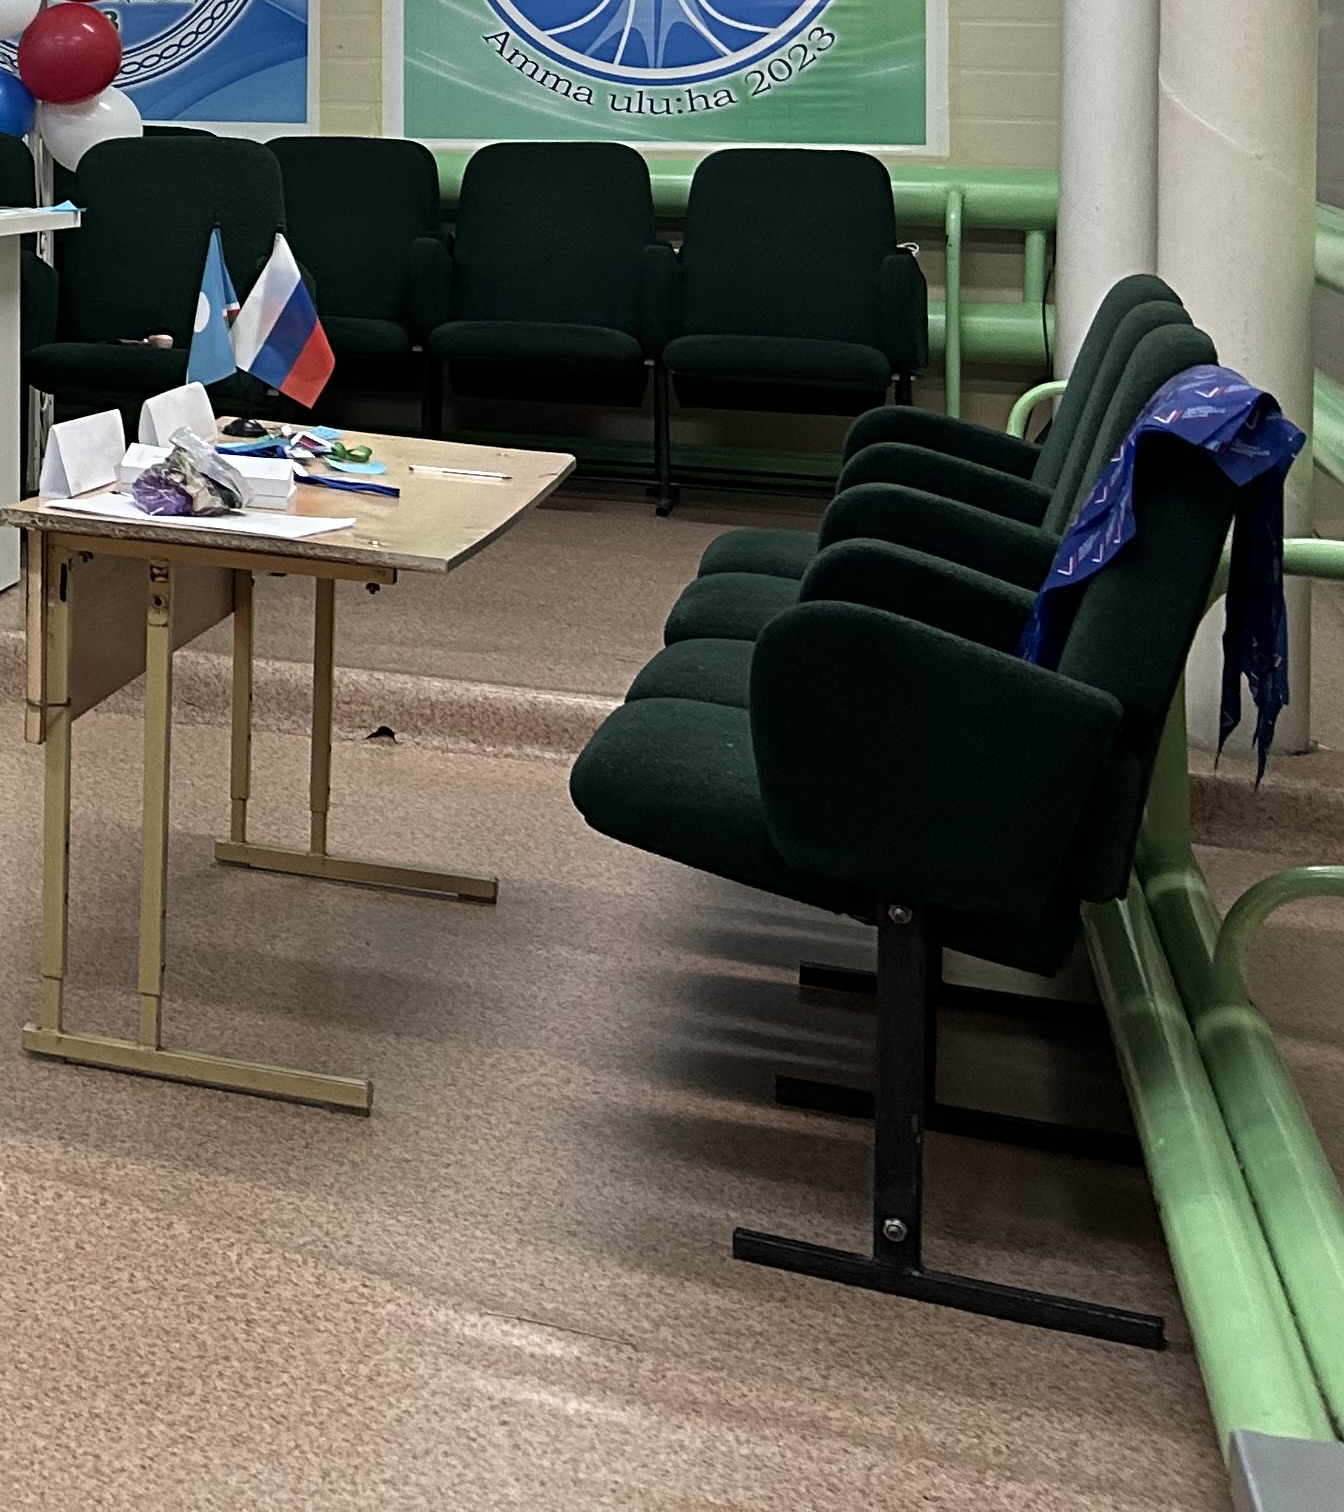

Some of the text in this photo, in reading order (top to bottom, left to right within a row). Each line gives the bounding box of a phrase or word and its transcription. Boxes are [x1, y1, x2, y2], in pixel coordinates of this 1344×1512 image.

[483, 26, 836, 115] Amma ulu:ha 2023
